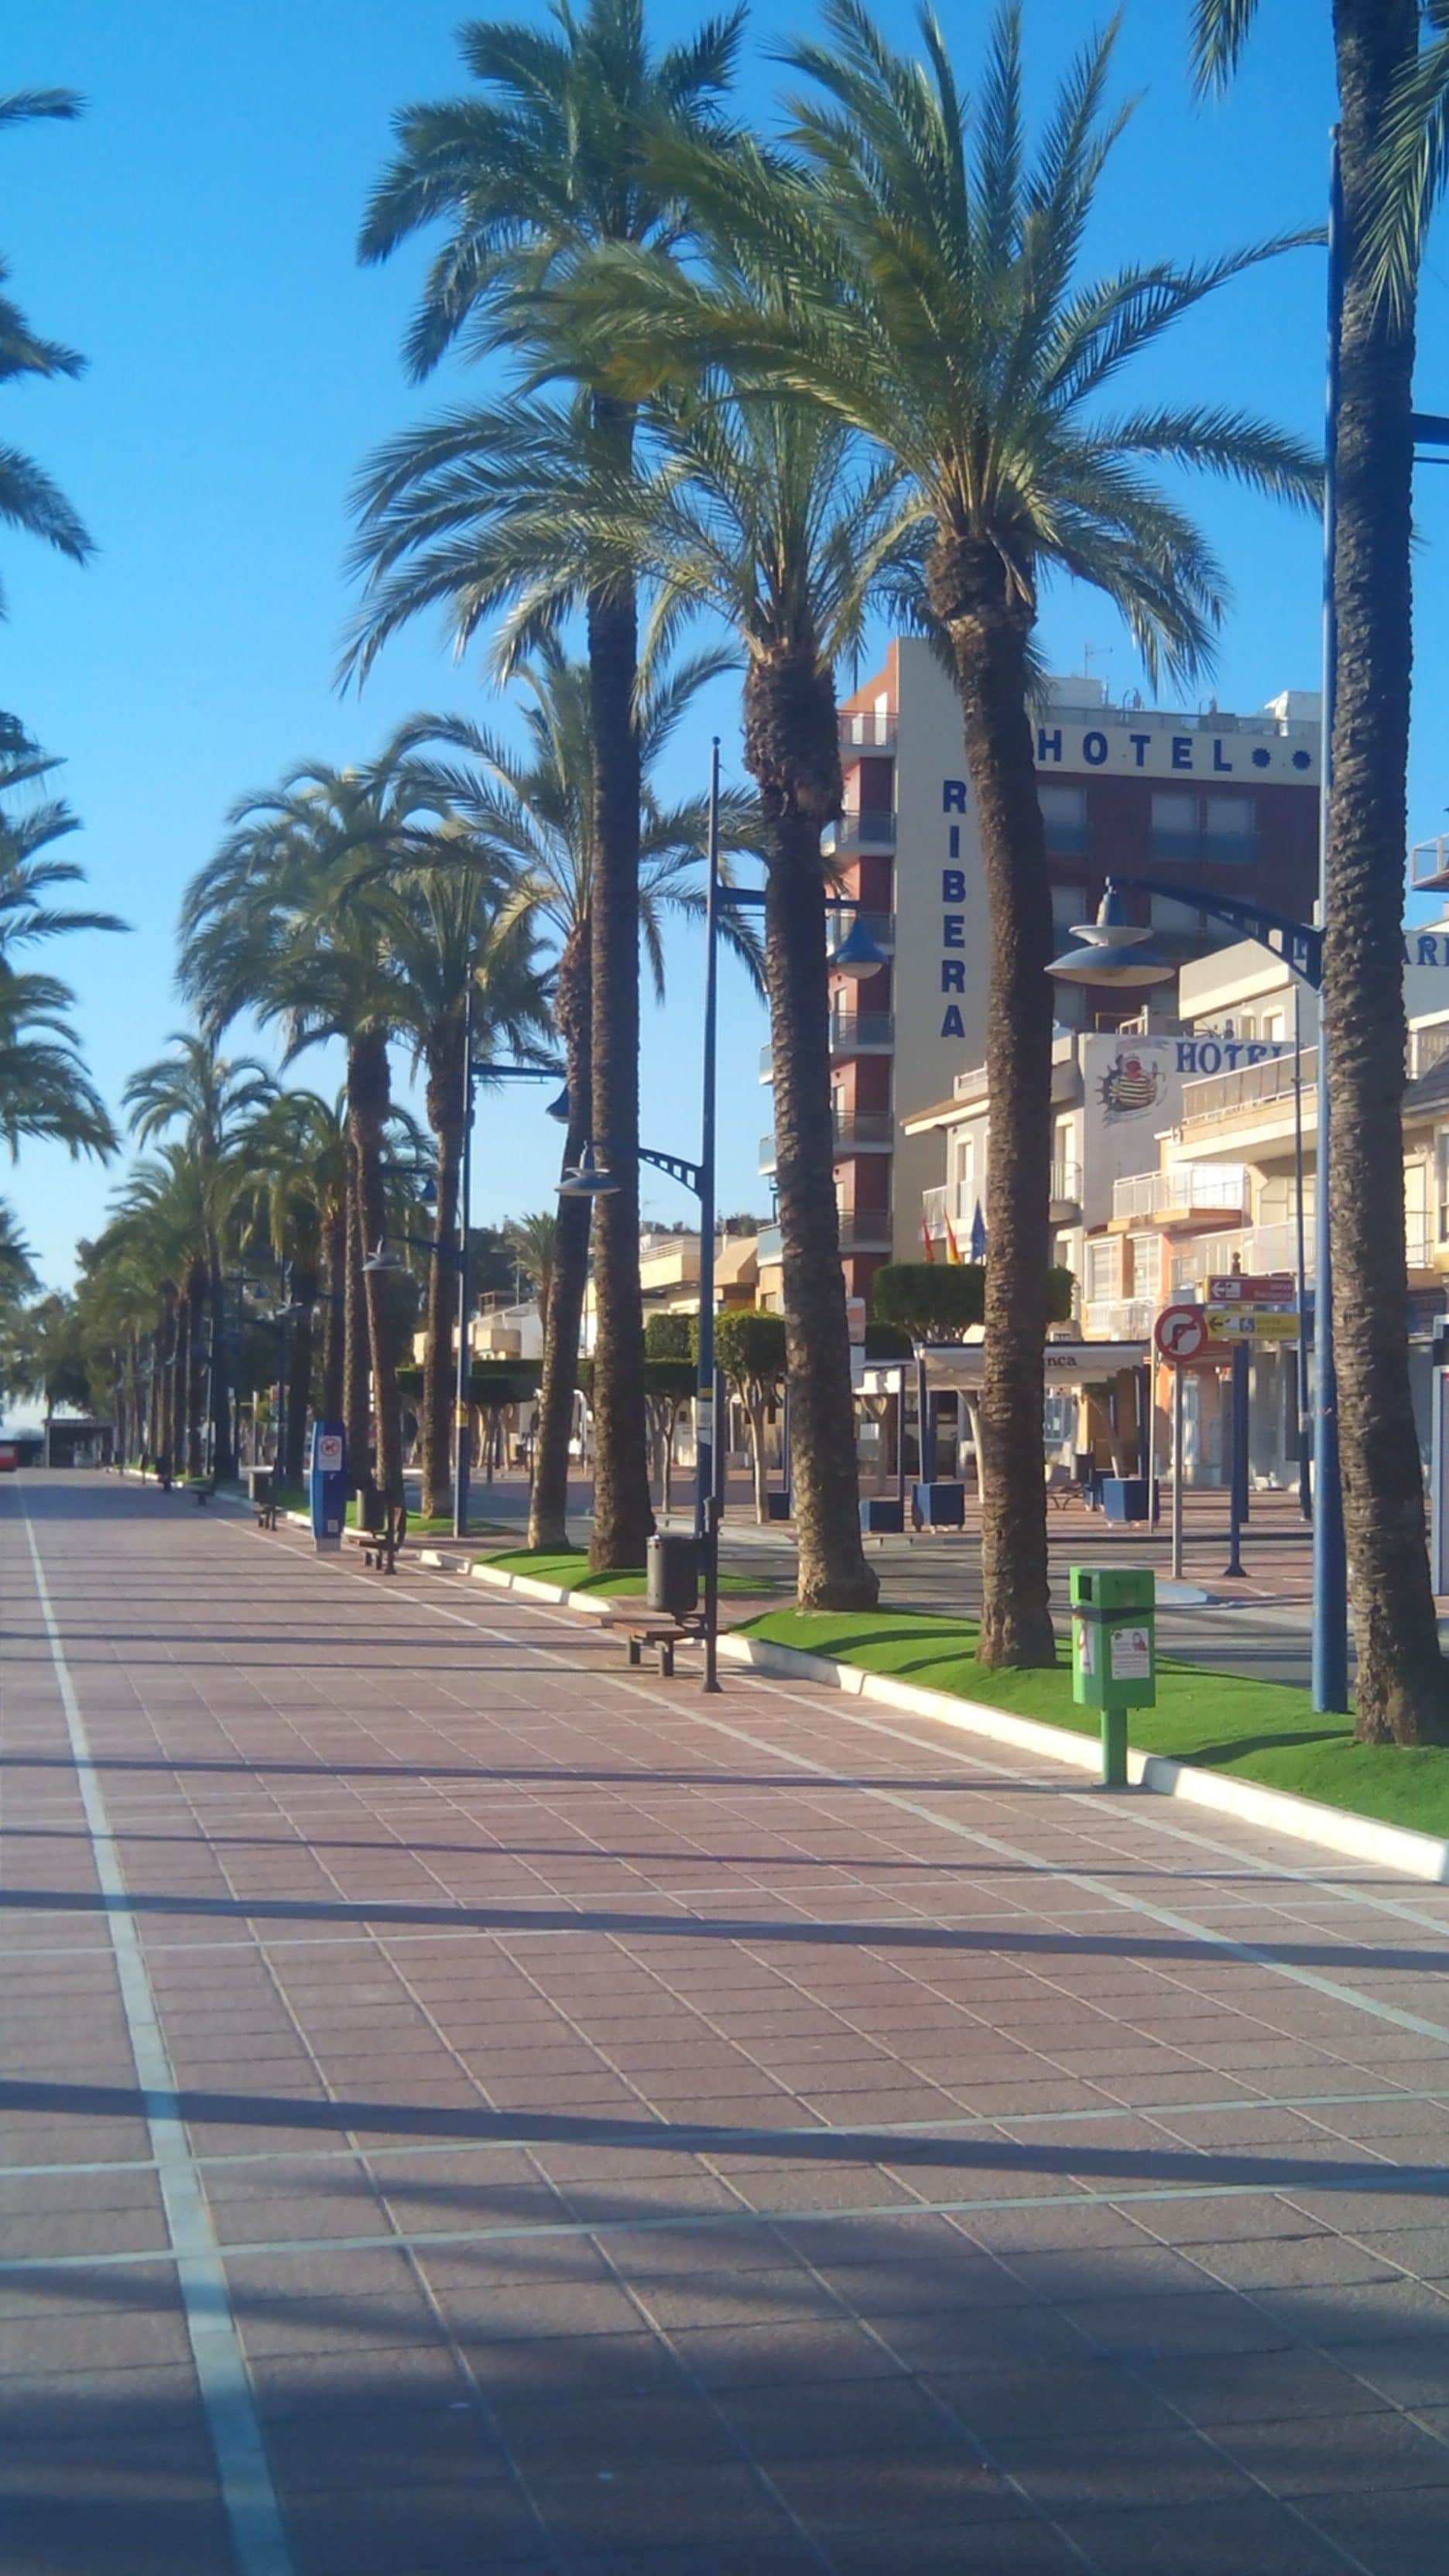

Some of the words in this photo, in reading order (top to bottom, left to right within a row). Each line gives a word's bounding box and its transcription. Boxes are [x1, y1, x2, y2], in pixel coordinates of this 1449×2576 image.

[1037, 728, 1233, 772] HOTEL
[940, 780, 968, 1038] RIBERA
[1046, 1355, 1077, 1367] nca
